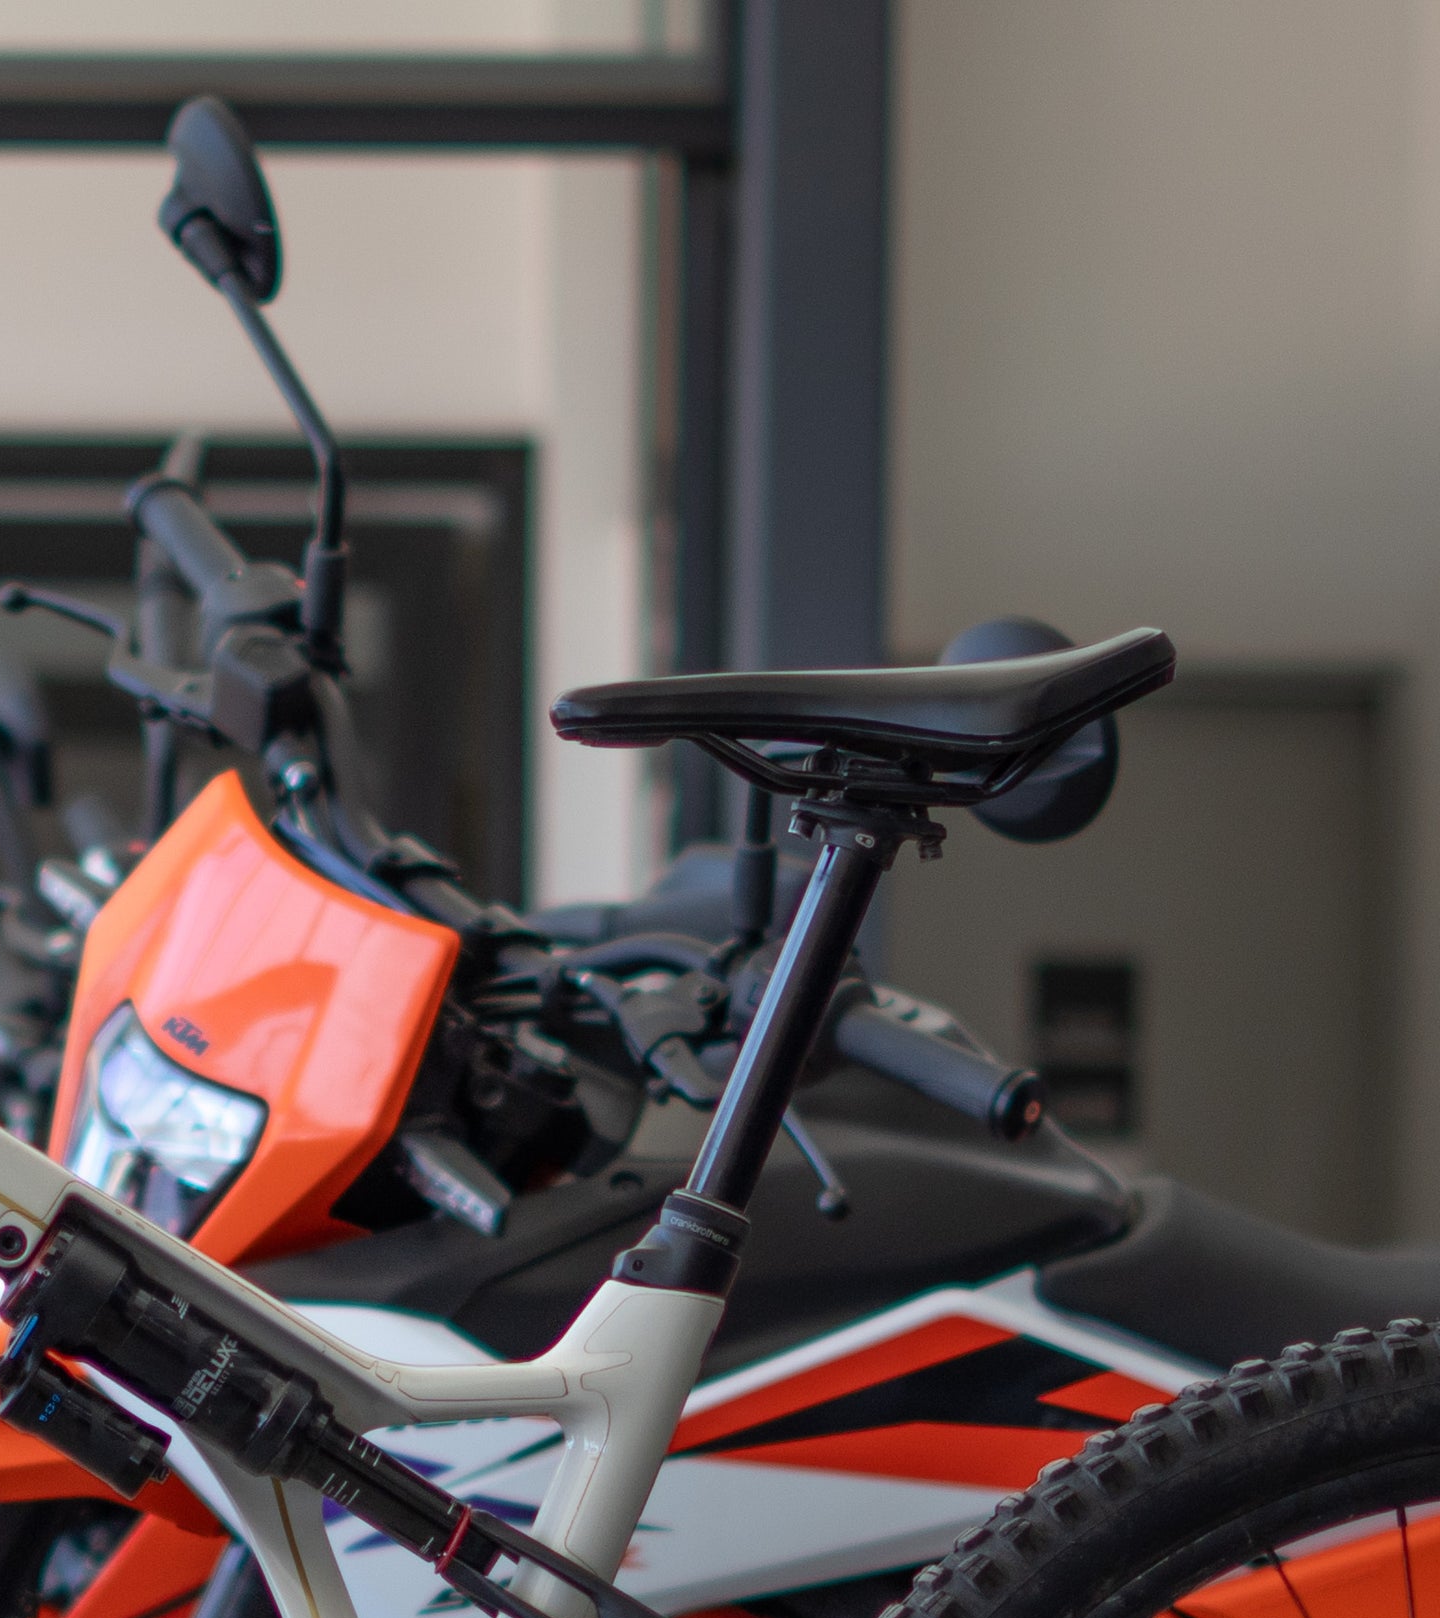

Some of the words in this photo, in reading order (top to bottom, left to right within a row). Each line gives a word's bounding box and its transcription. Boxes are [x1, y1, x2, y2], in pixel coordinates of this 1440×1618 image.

[161, 1017, 209, 1056] KTM
[670, 1216, 731, 1247] crankbrothers
[187, 1334, 239, 1406] DELUXE
